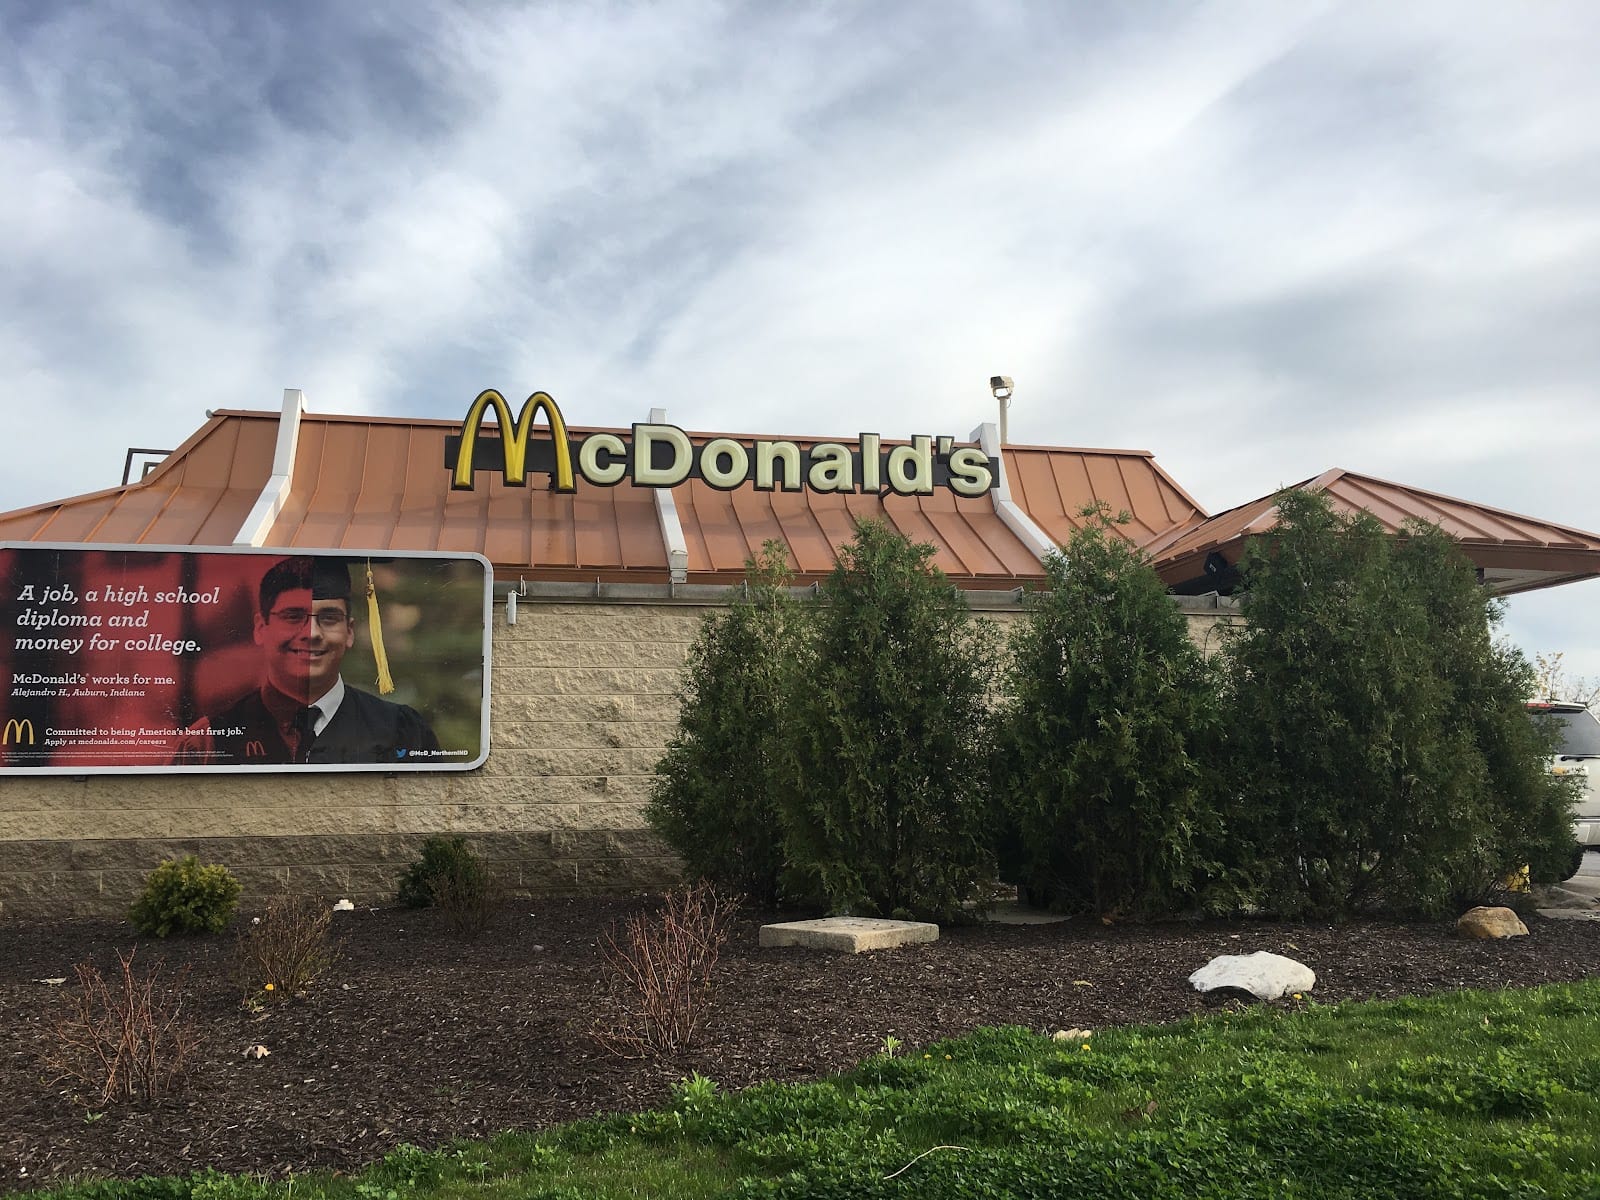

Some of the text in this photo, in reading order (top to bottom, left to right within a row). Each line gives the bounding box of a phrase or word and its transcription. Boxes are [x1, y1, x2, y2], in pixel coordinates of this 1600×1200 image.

[451, 389, 993, 498] McDonald's
[17, 584, 220, 606] A job, a high school
[16, 609, 150, 630] diploma and
[15, 633, 202, 655] money for college.
[92, 674, 130, 685] works
[133, 674, 152, 685] for
[154, 677, 176, 685] me.
[11, 688, 57, 697] Alejandro
[72, 689, 108, 698] Auburn,
[110, 689, 145, 697] Indiana
[45, 728, 98, 736] Committed
[111, 728, 136, 737] being
[138, 727, 184, 736] America's
[186, 728, 205, 736] best
[206, 728, 226, 736] first
[44, 739, 67, 747] Apply
[78, 738, 167, 746] mcdonalds.com/careers
